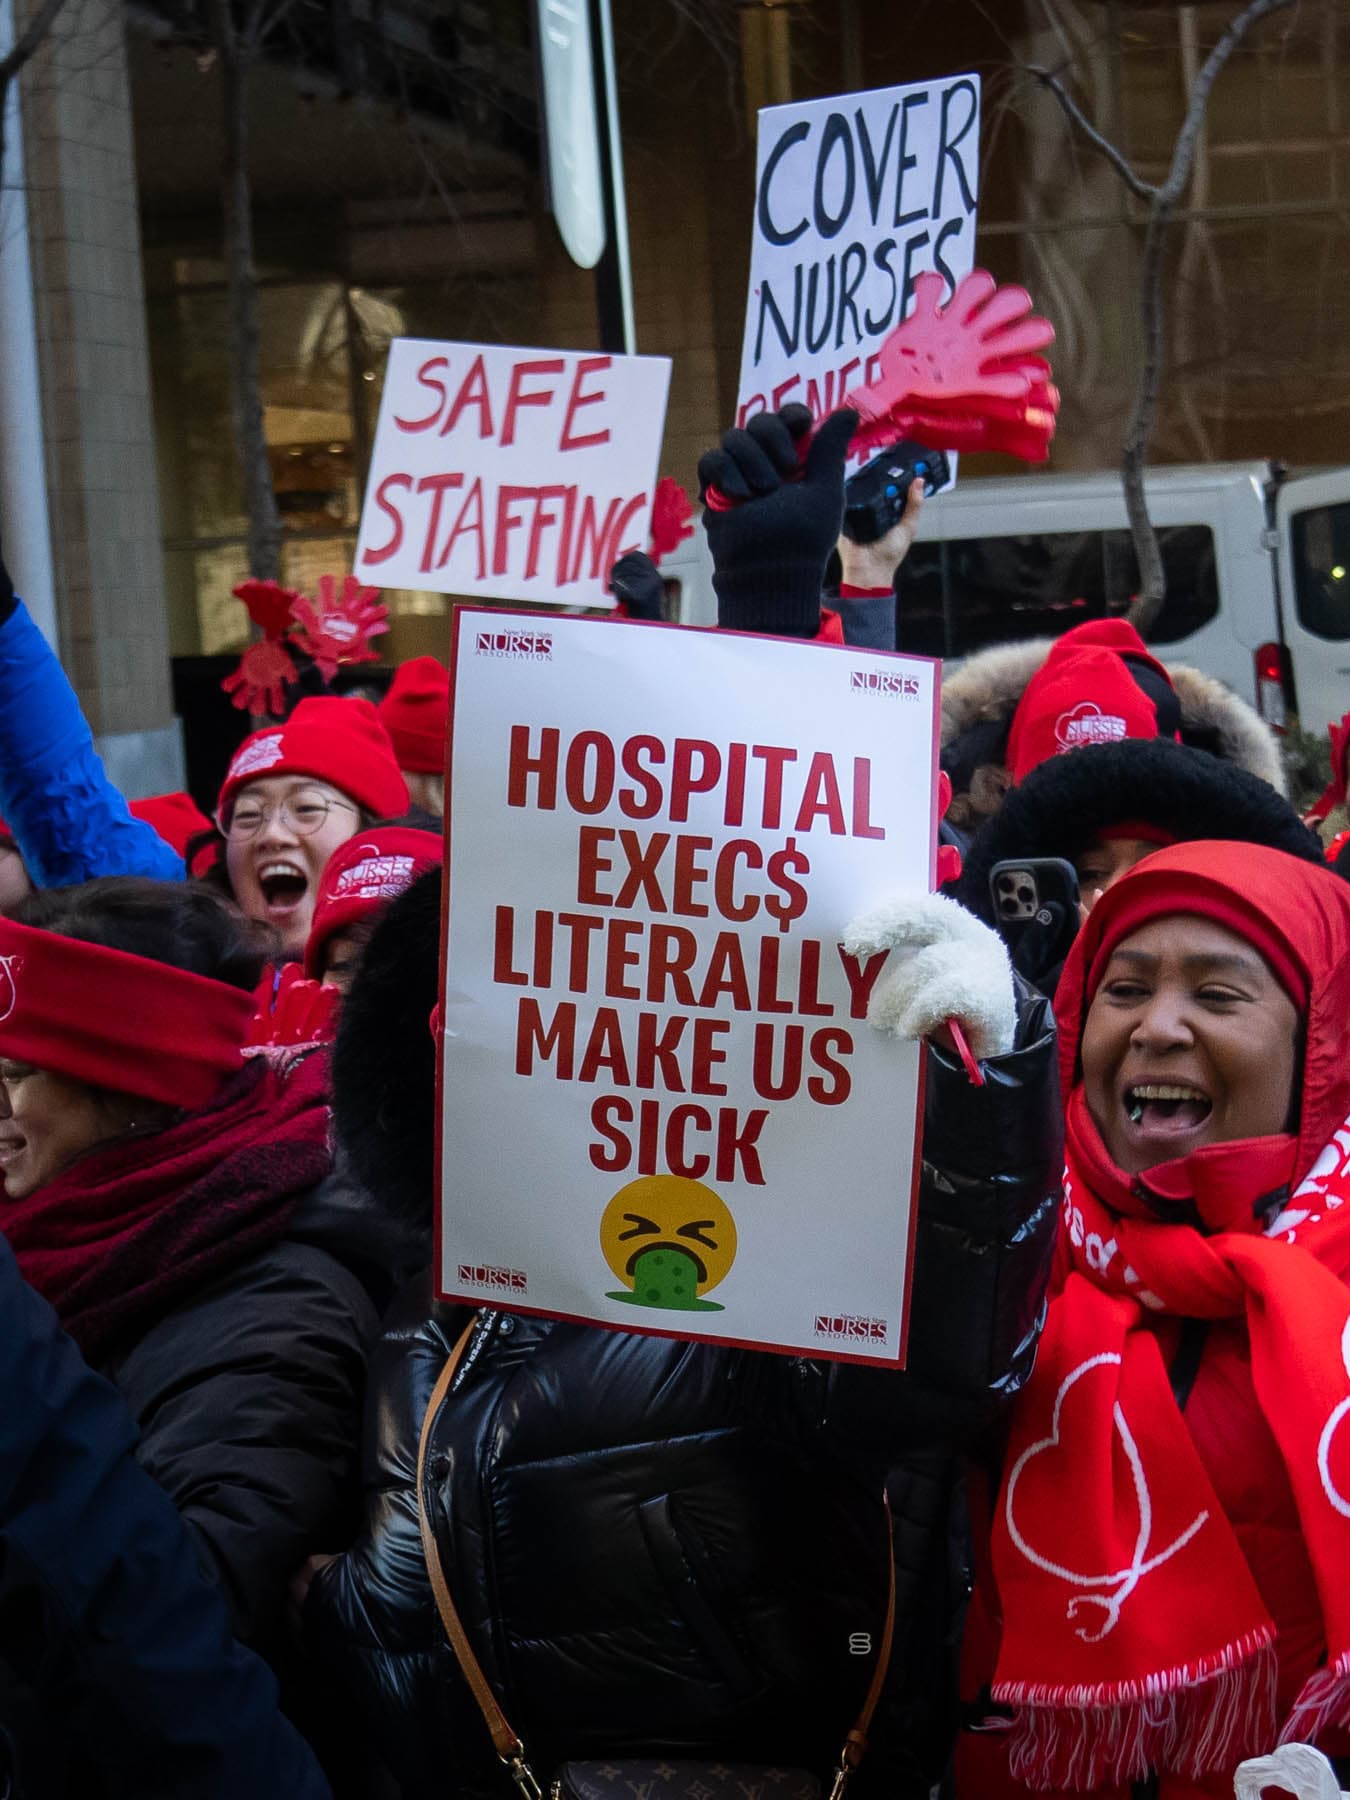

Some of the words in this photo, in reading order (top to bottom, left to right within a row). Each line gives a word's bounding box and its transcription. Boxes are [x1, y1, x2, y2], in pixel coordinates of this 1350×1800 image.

[757, 79, 978, 246] COVER
[753, 217, 963, 366] NURSES
[393, 354, 612, 451] SAFE
[475, 632, 552, 654] NURSES
[850, 671, 920, 695] NURSES
[507, 724, 886, 841] HOSPITAL
[577, 824, 811, 933] EXEC$
[493, 904, 891, 1021] LITERALLY
[514, 997, 731, 1096] MAKE
[753, 1021, 854, 1106] US
[588, 1093, 771, 1186] SICK
[458, 1264, 528, 1289] NURSES
[814, 1315, 887, 1338] NURSES
